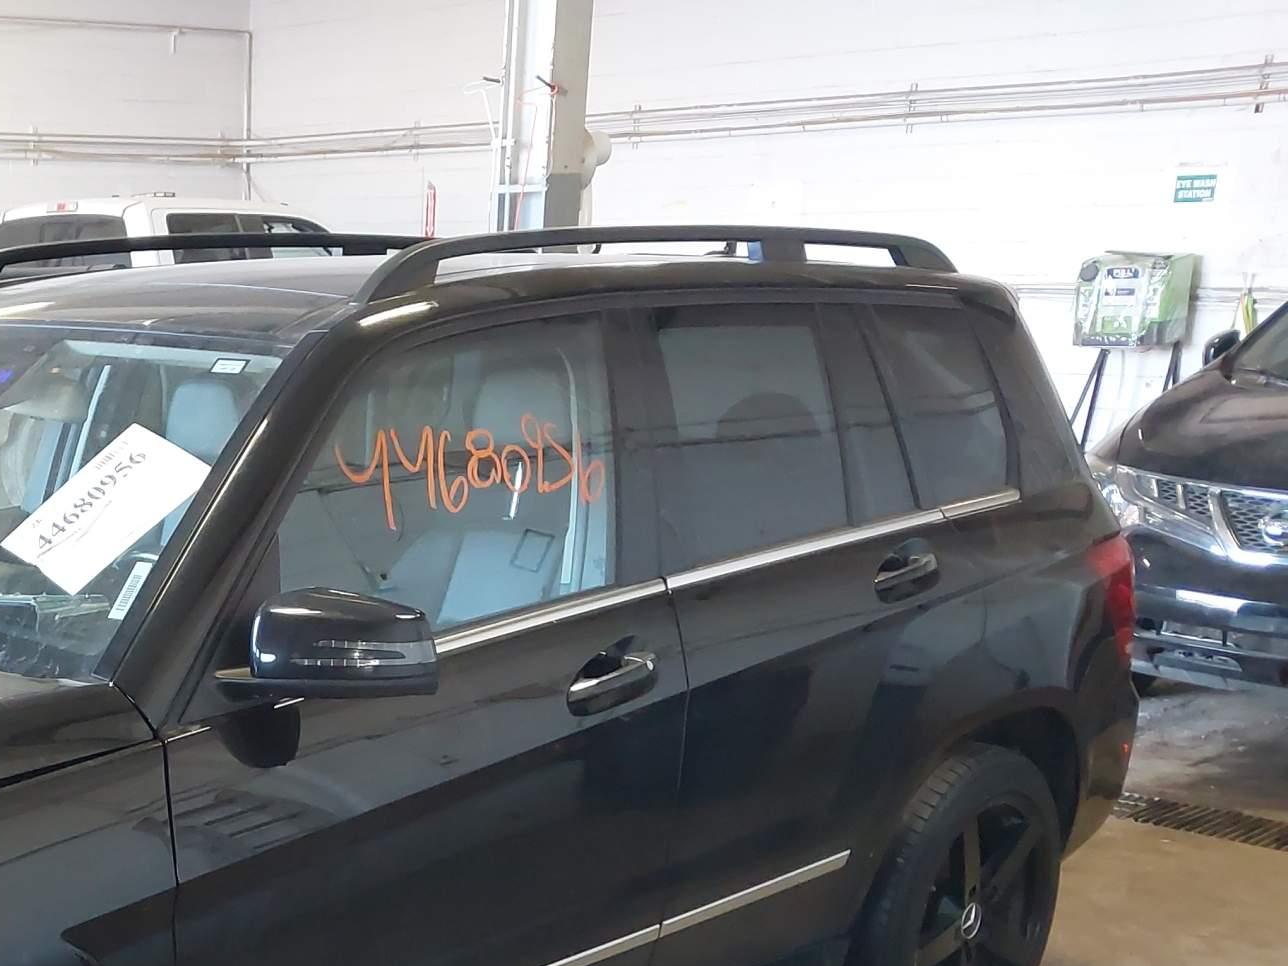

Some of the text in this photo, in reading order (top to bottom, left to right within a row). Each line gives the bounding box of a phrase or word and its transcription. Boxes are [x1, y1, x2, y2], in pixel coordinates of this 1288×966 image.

[1176, 179, 1217, 189] EYE WASH
[1177, 189, 1212, 199] STATION
[38, 451, 147, 549] 44680956
